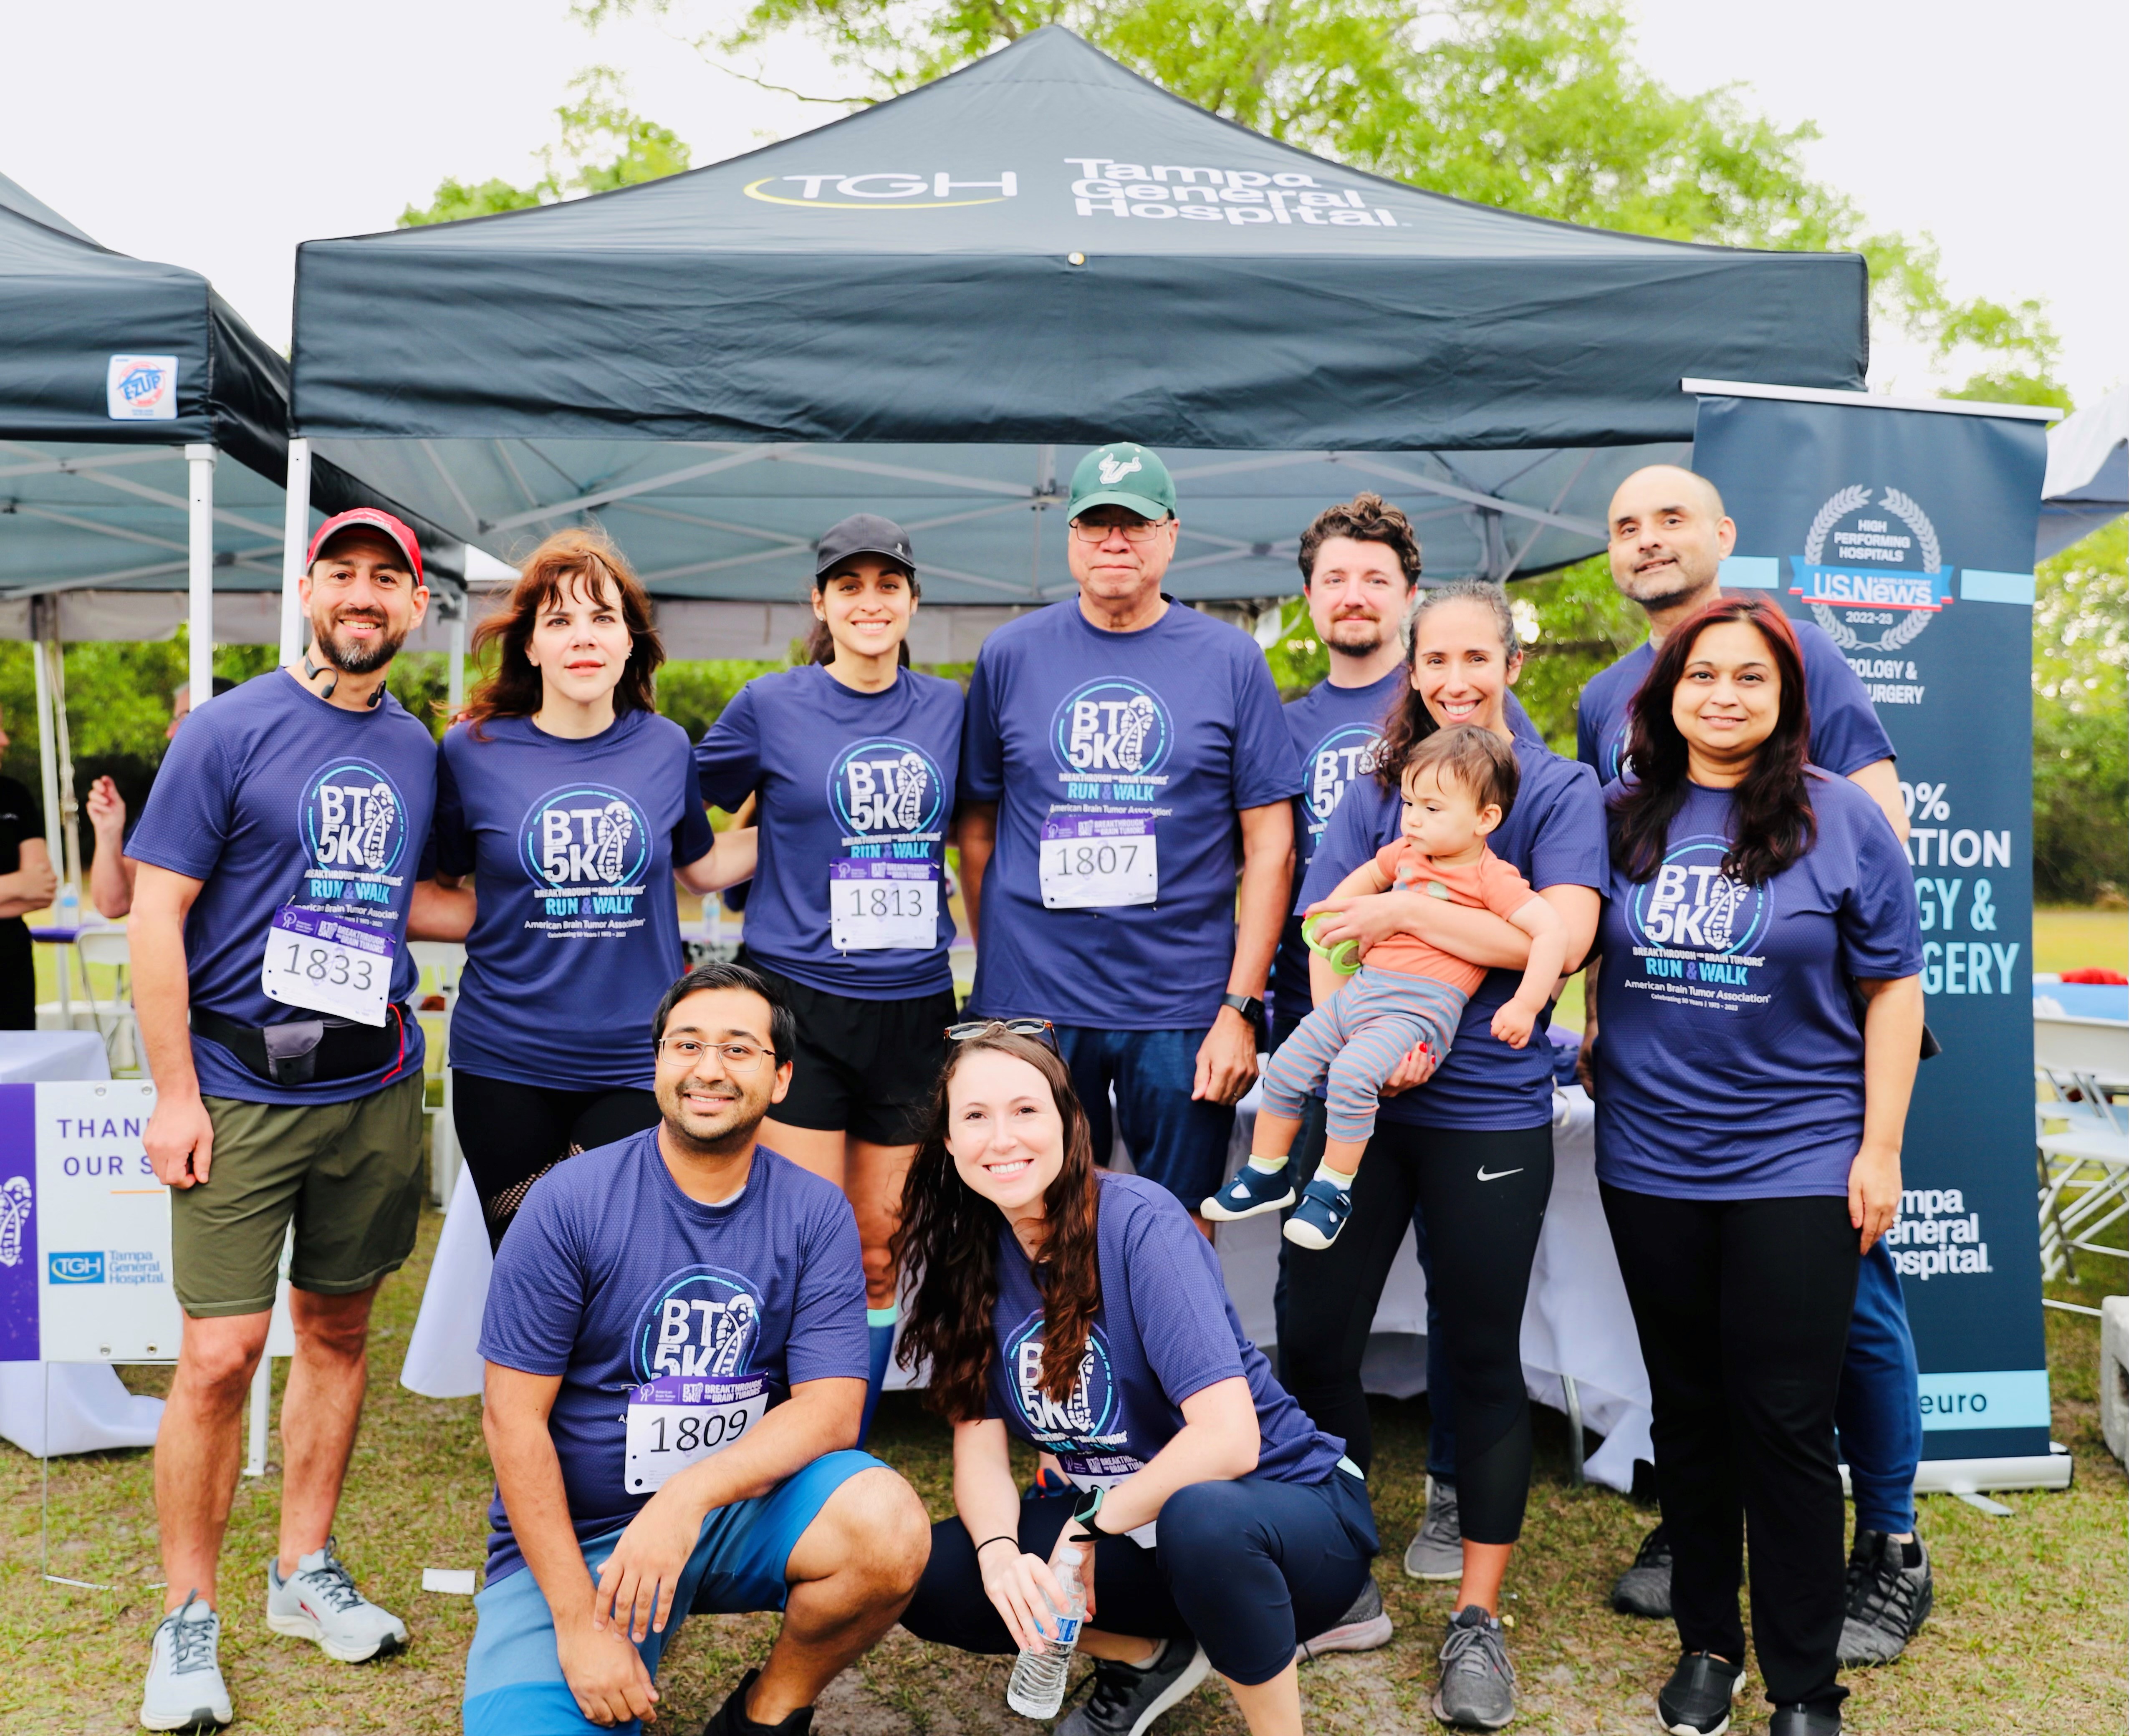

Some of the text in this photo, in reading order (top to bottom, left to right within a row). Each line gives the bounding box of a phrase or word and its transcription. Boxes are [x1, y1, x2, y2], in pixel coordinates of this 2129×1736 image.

[783, 171, 1018, 198] TGH
[1064, 158, 1321, 188] Tampa
[1071, 178, 1366, 208] General
[1858, 520, 1887, 533] HIGH
[1834, 532, 1911, 548] PERFORMING
[1839, 547, 1904, 563] HOSPITALS
[1846, 611, 1893, 625] 2022-23
[1905, 661, 1918, 680] &
[1072, 701, 1129, 735] BT
[1068, 733, 1121, 769] 5K
[846, 760, 900, 795] BT
[1314, 746, 1366, 785] BT
[1068, 782, 1155, 801] RUN & WALK
[319, 785, 371, 827] BT
[850, 794, 900, 830] 5K
[1050, 804, 1082, 812] American
[1083, 804, 1102, 812] Brain
[1103, 805, 1127, 814] Tumor
[543, 808, 604, 847] BT
[316, 823, 365, 865] 5K
[851, 844, 881, 858] RUN
[893, 842, 930, 858] WALK
[543, 844, 600, 883] 5K
[1057, 845, 1138, 876] 1807
[311, 879, 390, 904] RUN & WALK
[1652, 864, 1722, 906] BT
[293, 904, 324, 913] merican
[324, 904, 345, 913] Brain
[545, 896, 634, 916] RUN & WALK
[850, 888, 922, 916] 1813
[1970, 878, 1997, 931] &
[524, 920, 562, 930] American
[563, 920, 582, 929] Brain
[583, 920, 607, 929] Tumor
[1644, 901, 1710, 946] 5K
[283, 944, 372, 990] 1833
[1632, 946, 1696, 960] BREAKTHROUGH
[1705, 952, 1728, 964] BRAIN
[1646, 958, 1748, 986] RUN & WALK
[1625, 979, 1666, 992] American
[1667, 982, 1688, 995] Brain
[1688, 986, 1715, 998] Tumor
[57, 1118, 150, 1138] THAN
[64, 1156, 124, 1176] OUR
[1897, 1188, 1965, 1219] mpa
[58, 1257, 101, 1274] TGH
[109, 1250, 152, 1262] Tampa
[110, 1261, 160, 1272] General
[658, 1298, 726, 1347] BT
[705, 1379, 762, 1394] BREAKTHROUGH
[712, 1392, 734, 1403] BRAIN
[735, 1388, 760, 1400] TUMORS
[1920, 1394, 1987, 1414] euro
[651, 1409, 748, 1452] 1809
